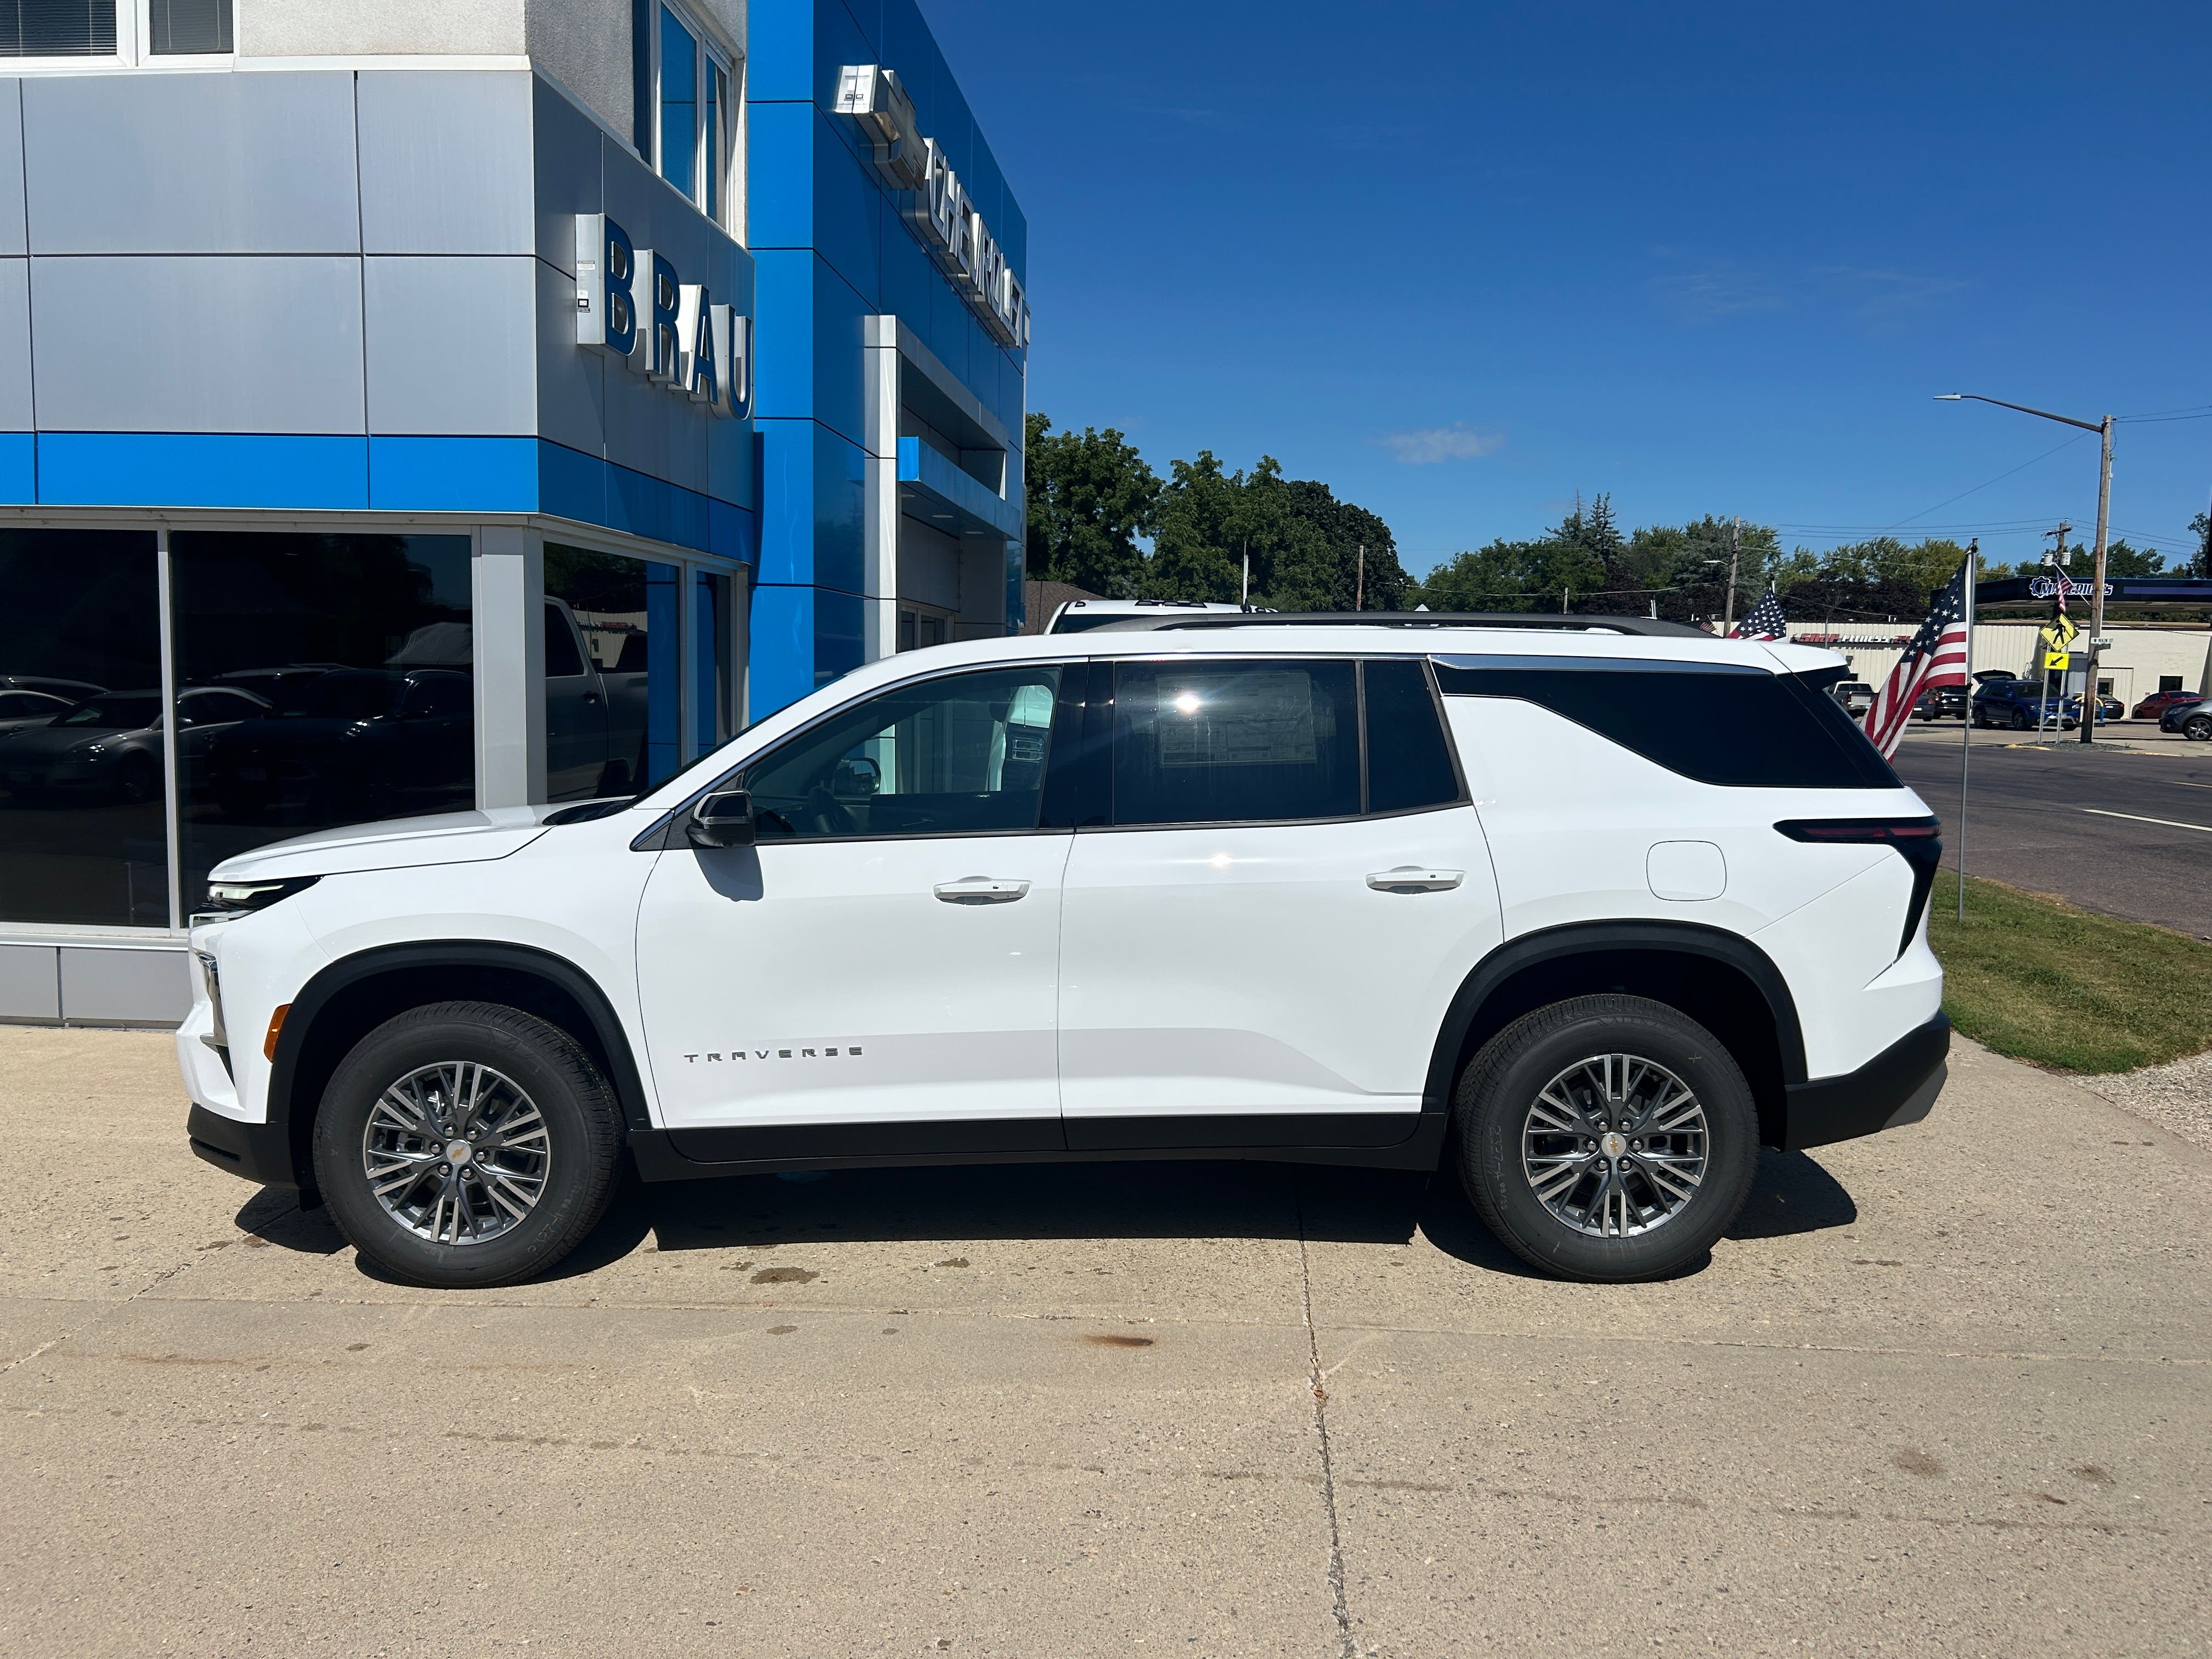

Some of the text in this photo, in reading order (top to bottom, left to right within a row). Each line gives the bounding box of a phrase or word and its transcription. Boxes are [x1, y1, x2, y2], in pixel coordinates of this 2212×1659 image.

[598, 213, 754, 420] BRAU
[923, 138, 1025, 348] CHEVROLET
[684, 1047, 863, 1063] TRAVERSE
